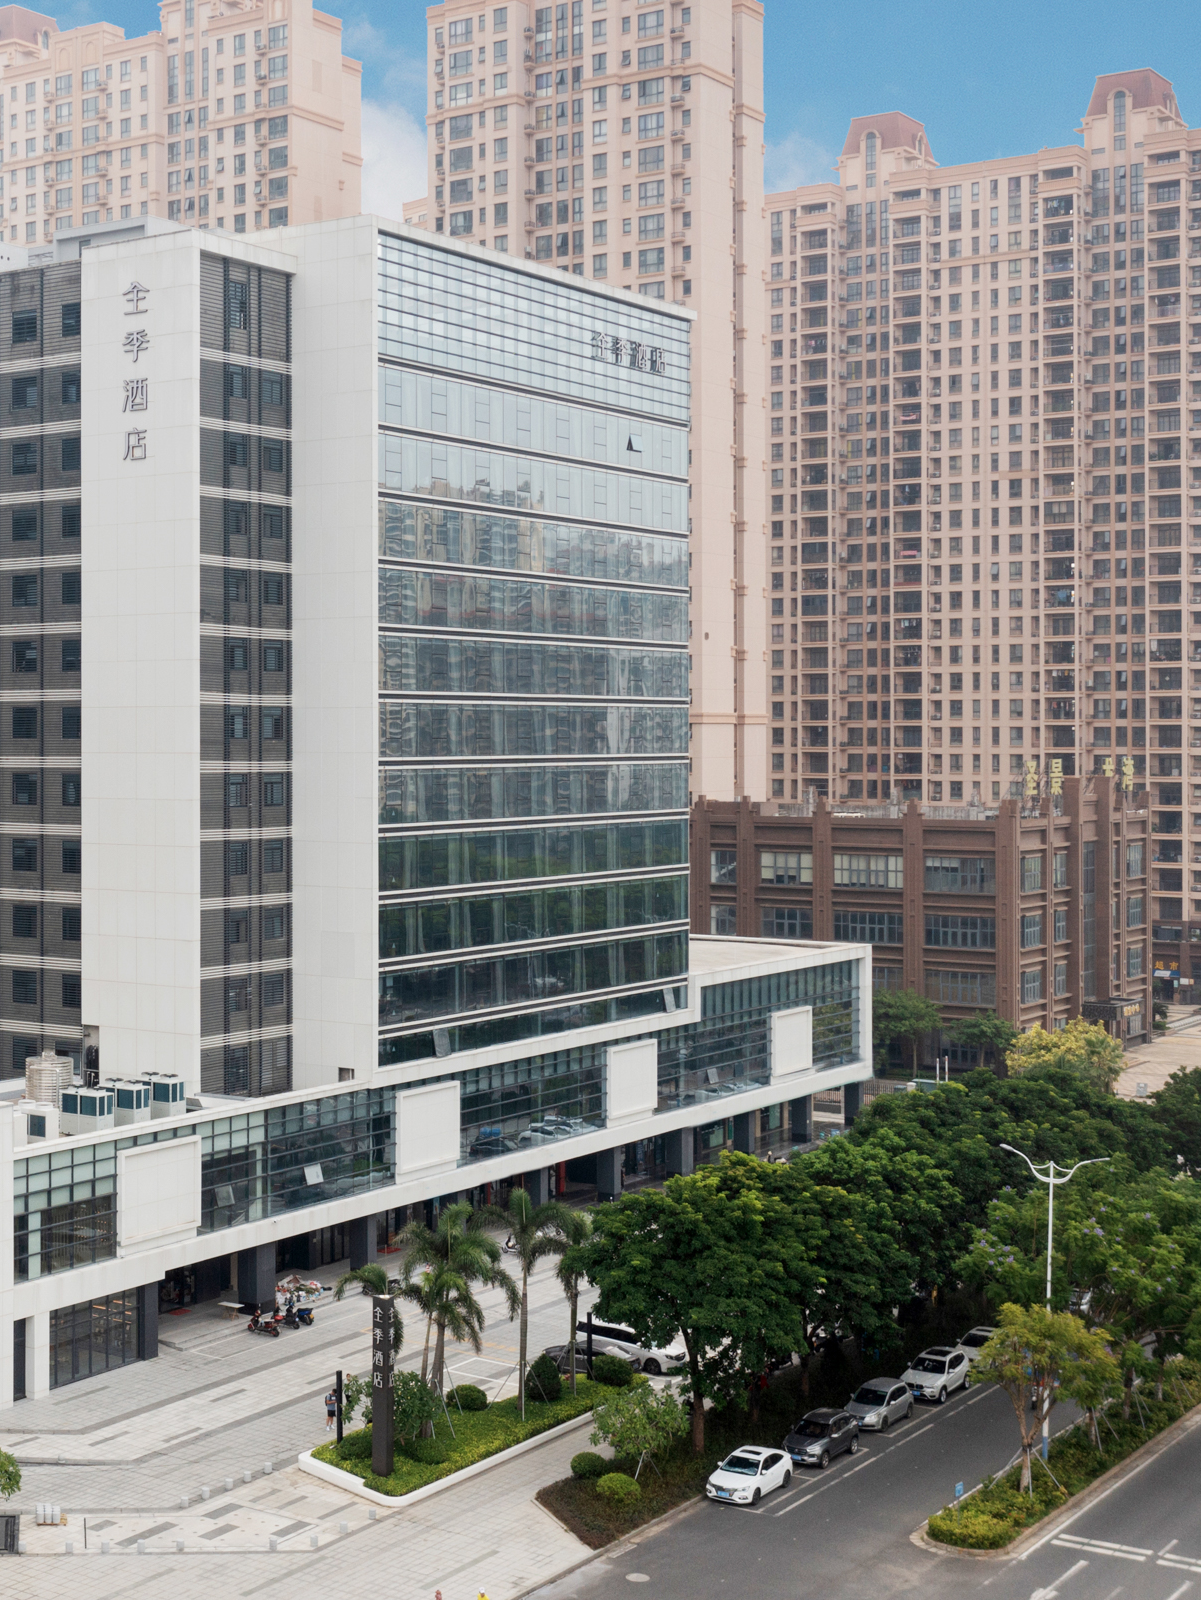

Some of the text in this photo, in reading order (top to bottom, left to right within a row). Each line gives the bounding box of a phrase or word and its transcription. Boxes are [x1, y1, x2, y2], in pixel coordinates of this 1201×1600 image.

[122, 281, 150, 461] 全季酒店
[597, 332, 668, 375] 全季酒店
[373, 1307, 384, 1389] 全季酒店
